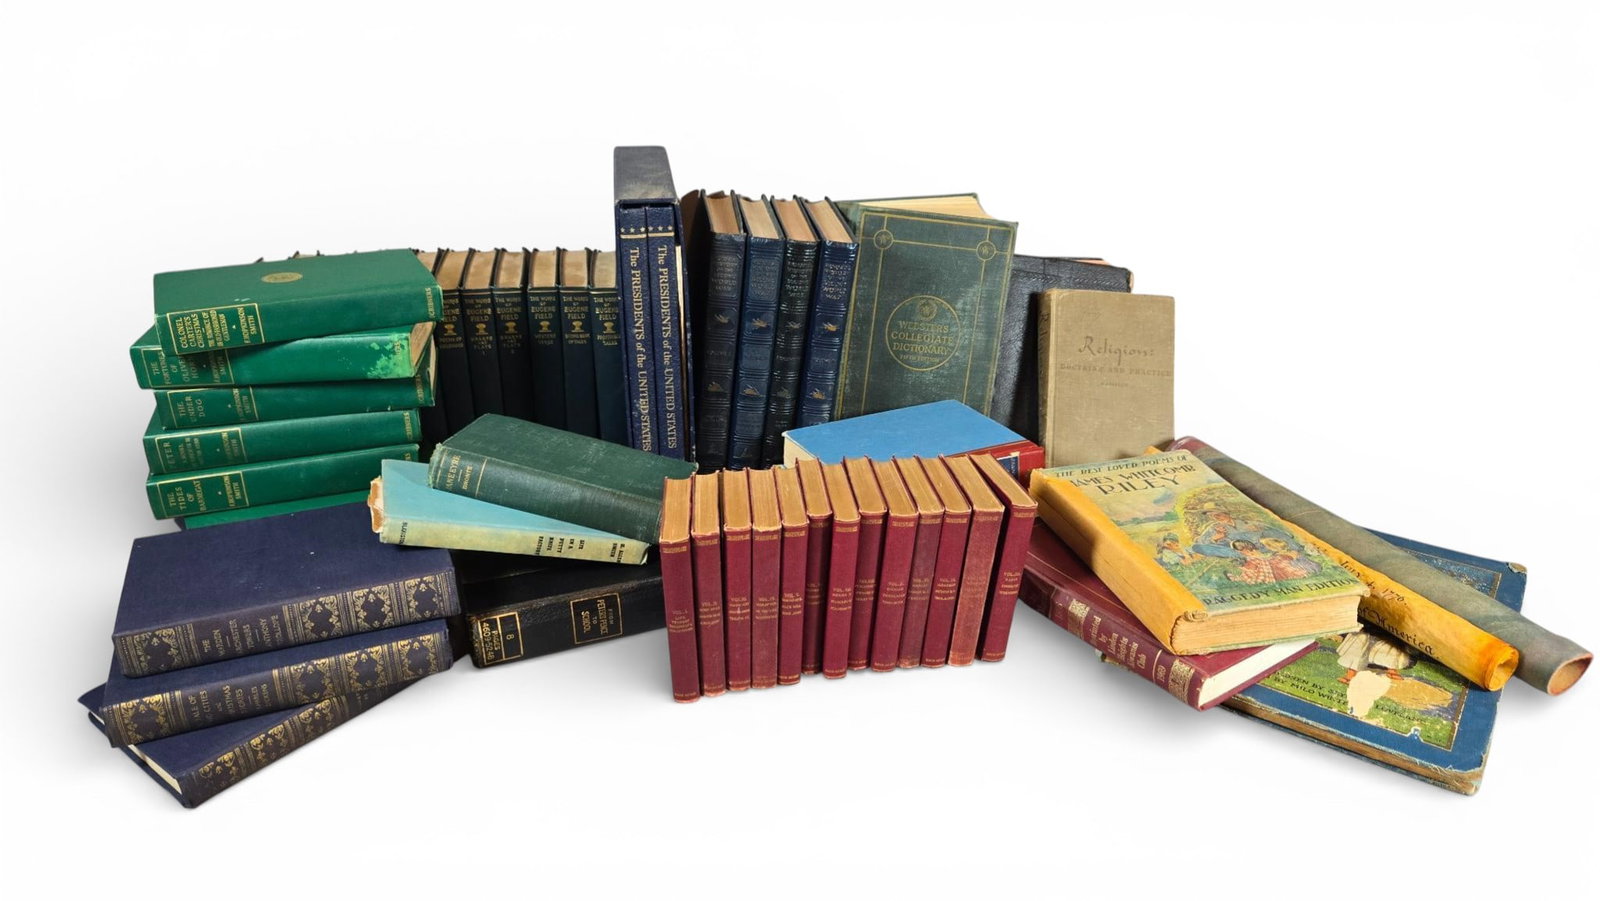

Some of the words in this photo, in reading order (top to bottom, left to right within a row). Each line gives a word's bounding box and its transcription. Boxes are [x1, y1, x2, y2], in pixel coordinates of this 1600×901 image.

[629, 246, 639, 266] The
[657, 245, 667, 265] The
[631, 269, 645, 340] PRESIDENTS
[659, 268, 673, 337] PRESIDENTS
[176, 317, 188, 348] COLONEL
[191, 313, 204, 348] CHRISTMAS
[248, 315, 257, 335] SMITH
[636, 341, 646, 355] of
[663, 339, 673, 352] of
[891, 331, 954, 345] COLLEGIATE
[893, 342, 952, 356] DICTIONARY
[151, 362, 160, 376] THE
[170, 364, 178, 373] OF
[663, 353, 672, 367] the
[1060, 363, 1105, 373] DOCTRINE
[1109, 367, 1125, 375] AND
[1129, 368, 1171, 377] PRACTICE
[638, 370, 649, 413] UNITED
[664, 368, 675, 410] UNITED
[177, 402, 186, 416] THE
[195, 399, 205, 417] DOG
[640, 413, 652, 452] STATES
[668, 411, 677, 449] STATES
[450, 455, 461, 473] EYRE
[1081, 466, 1103, 475] BEST
[1107, 462, 1138, 472] LOVED
[1142, 457, 1174, 467] POEMS
[462, 465, 473, 490] BRONTE
[1070, 476, 1114, 488] JAMES
[1119, 464, 1196, 481] WHITCOMB
[1096, 475, 1180, 496] RILEY
[167, 492, 177, 507] THE
[175, 487, 187, 510] TIDES
[186, 492, 194, 502] OF
[232, 482, 241, 499] SMITH
[1203, 590, 1272, 606] RAGGEDY
[1274, 585, 1305, 596] MAN
[1307, 577, 1359, 591] EDITION
[582, 610, 591, 633] SCHOOL
[593, 616, 598, 625] TO
[259, 618, 272, 647] ANTHONY
[491, 630, 501, 651] PAGES
[202, 639, 211, 653] THE
[1137, 653, 1147, 669] Club
[189, 694, 197, 705] OF
[1274, 676, 1286, 684] BY
[1291, 683, 1315, 694] MILO
[1318, 692, 1348, 705] WINTE
[199, 690, 211, 713] CITIES
